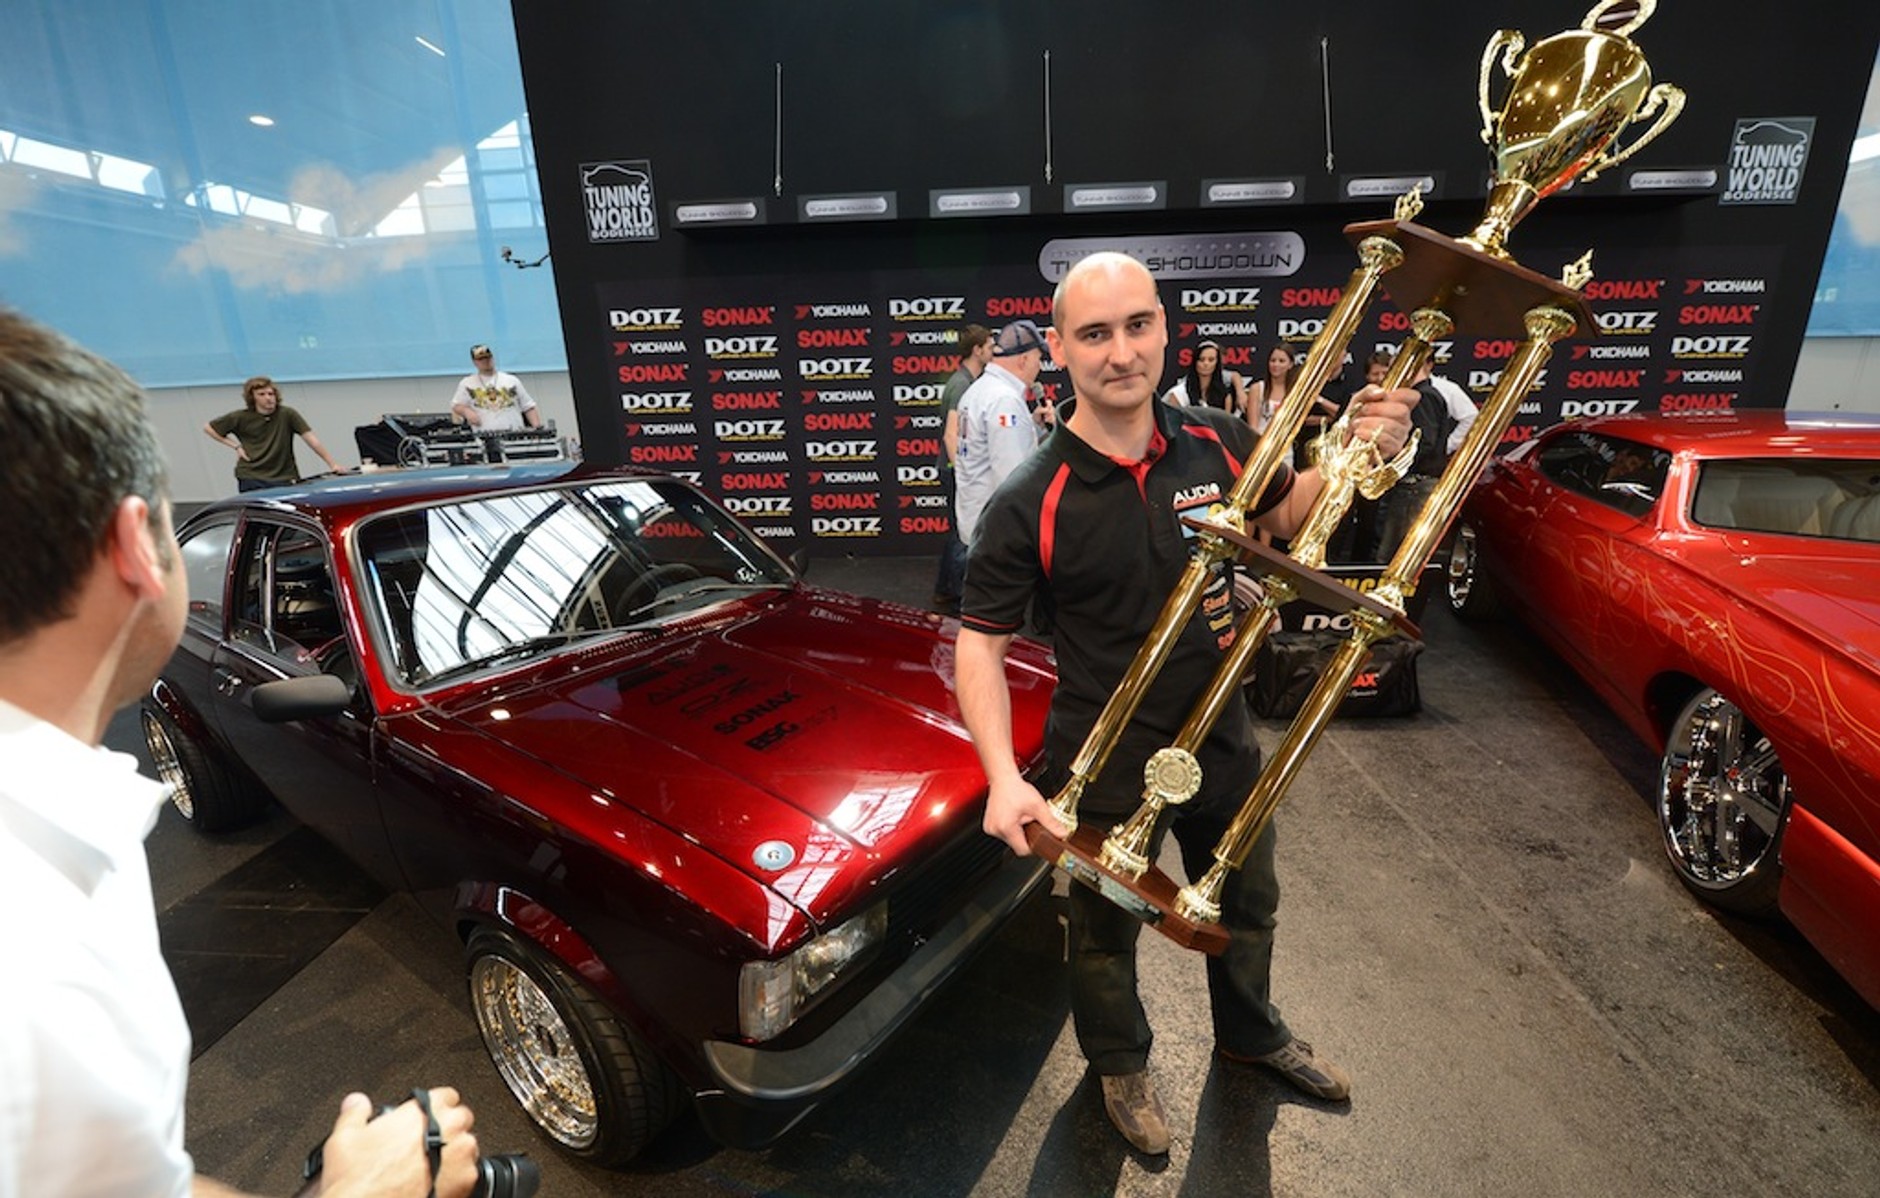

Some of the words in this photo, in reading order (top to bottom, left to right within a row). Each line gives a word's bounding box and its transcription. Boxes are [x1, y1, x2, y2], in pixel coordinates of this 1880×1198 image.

[1732, 145, 1803, 167] TUNING
[1730, 169, 1798, 191] WORLD
[586, 185, 650, 208] TUNING
[589, 207, 654, 230] WORLD
[1147, 253, 1292, 273] SHOWDOWN
[1584, 281, 1659, 299] SONAX
[1704, 280, 1764, 292] YOKOHAMA
[1181, 288, 1260, 307] DOTZ
[1282, 288, 1342, 308] SONA
[812, 305, 870, 317] YOKOHAMA
[889, 298, 965, 316] DOTZ
[1680, 306, 1755, 324] SONAX
[610, 309, 683, 327] DOTZ
[703, 308, 771, 326] SONAX
[1197, 323, 1257, 335] YOKOHAMA
[1278, 320, 1327, 337] DO
[705, 337, 778, 354] DOTZ
[798, 330, 867, 347] SONAX
[907, 332, 958, 344] YOKOHAM
[1671, 336, 1751, 353] DOTZ
[630, 342, 686, 353] YOKOHAMA
[1590, 346, 1649, 358] YOKOHAMA
[619, 364, 685, 382] SONAX
[799, 358, 872, 375] DOTZ
[893, 356, 961, 374] SONAX
[724, 369, 781, 381] YOKOHAMA
[1568, 371, 1639, 388] SONAX
[1683, 371, 1742, 382] YOKOHAMA
[712, 392, 779, 409] SONAX
[818, 390, 874, 402] YOKOHAMA
[893, 384, 946, 401] DOT
[622, 393, 693, 410] DOTZ
[1561, 400, 1639, 416] DOTZ
[1660, 394, 1733, 413] SONAX
[641, 424, 696, 435] YOKOHAMA
[715, 420, 785, 437] DOTZ
[805, 413, 872, 430] SONAX
[631, 446, 695, 462] SONAX
[806, 441, 877, 458] DOTZ
[897, 440, 940, 456] SON
[733, 452, 788, 463] YOKOHAMA
[722, 473, 786, 489] SONAX
[824, 472, 879, 483] YOKOHAMA
[898, 467, 938, 482] DO
[723, 498, 792, 512] DOTZ
[811, 494, 876, 510] SONAX
[812, 518, 881, 533] DOTZ
